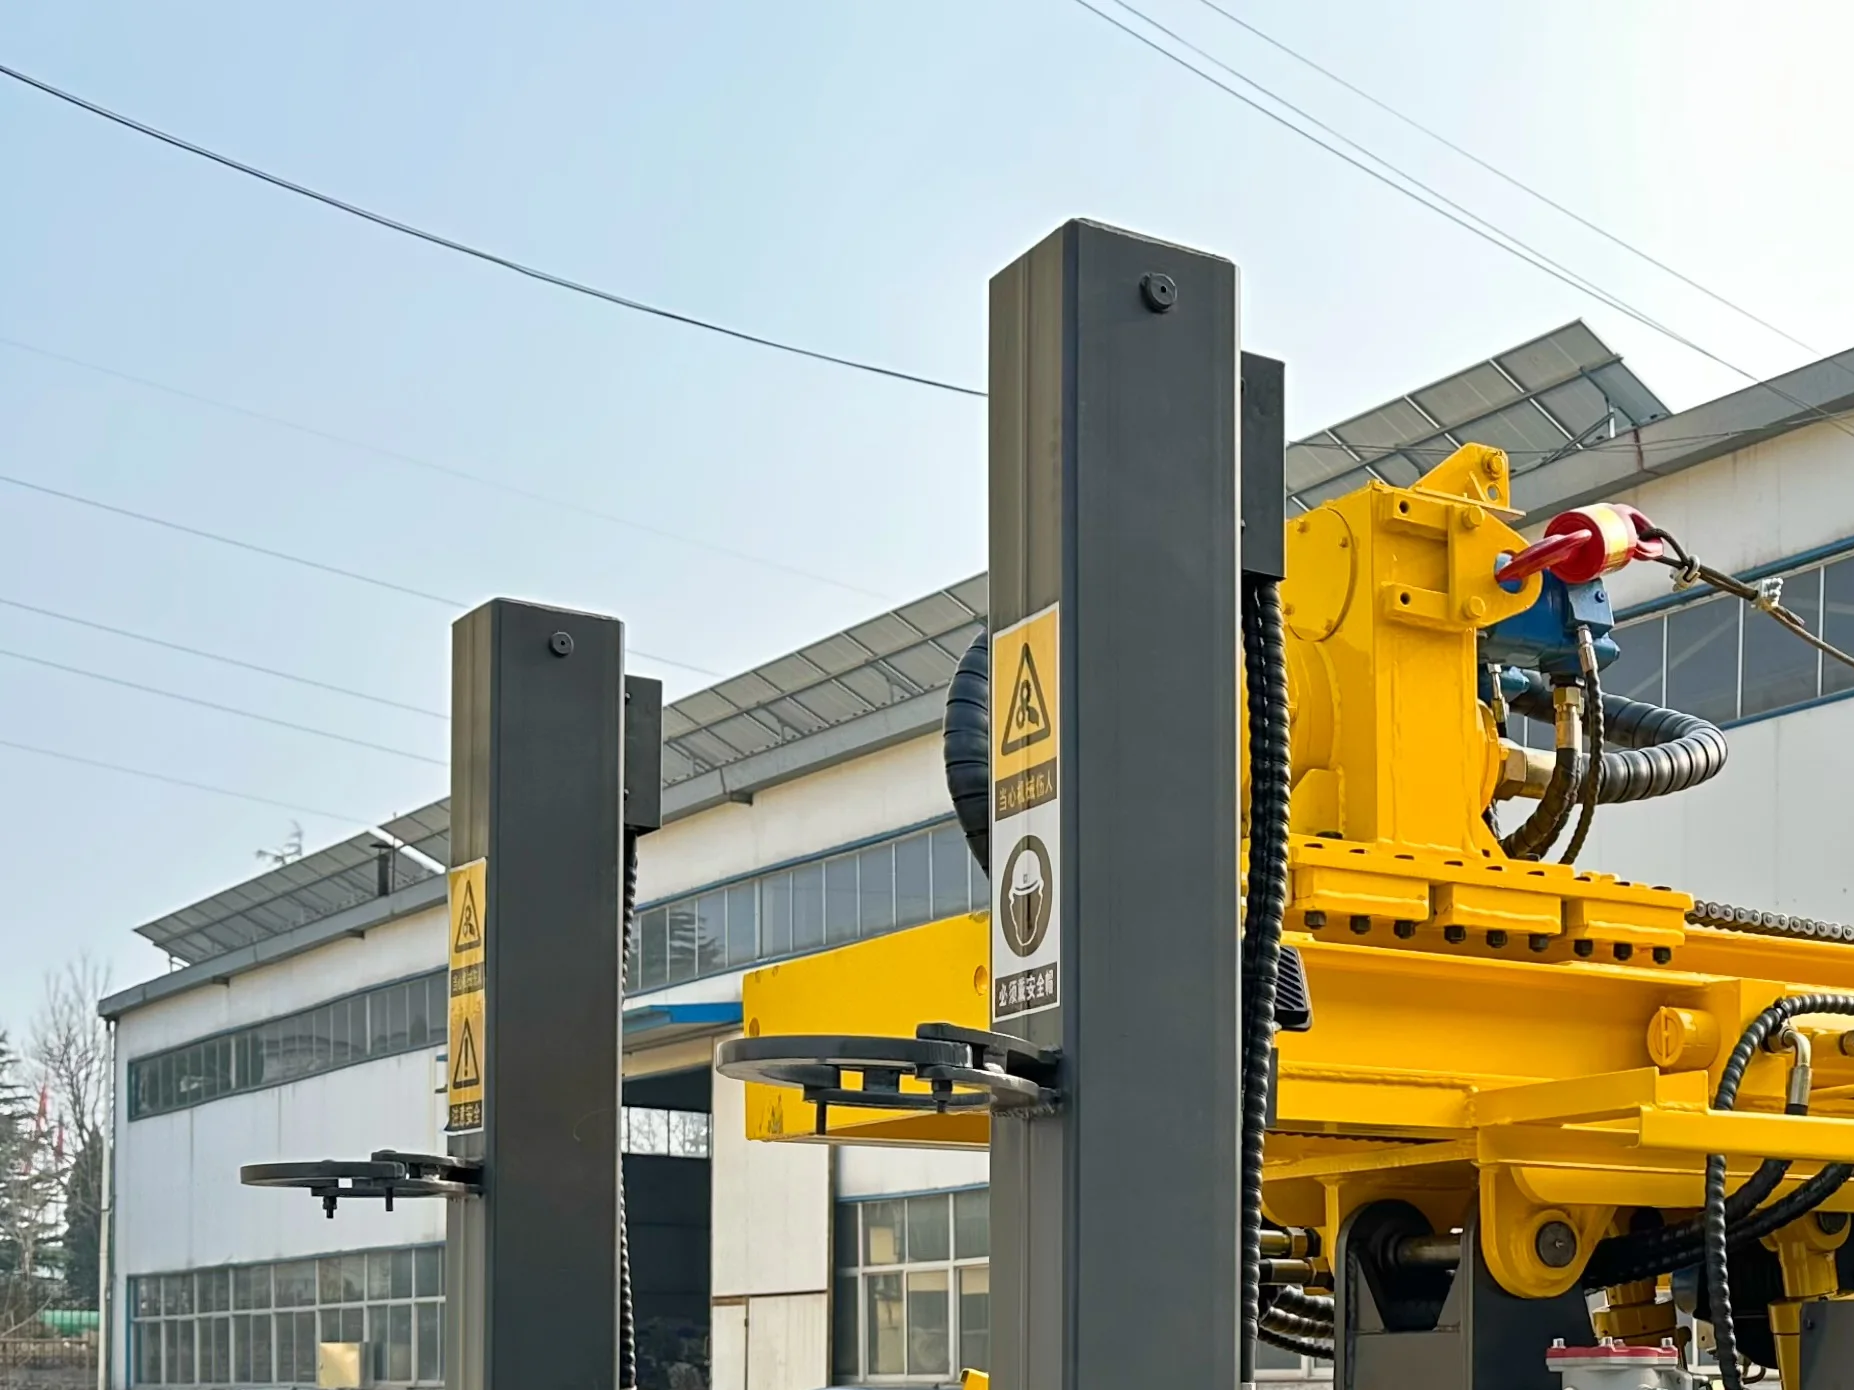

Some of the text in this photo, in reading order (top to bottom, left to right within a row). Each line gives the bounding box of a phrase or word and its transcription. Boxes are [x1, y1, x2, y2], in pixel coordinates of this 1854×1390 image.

[999, 769, 1053, 811] 当心机械伤人
[999, 969, 1054, 1007] 必须戴安全帽
[451, 1102, 480, 1127] 注意安全
